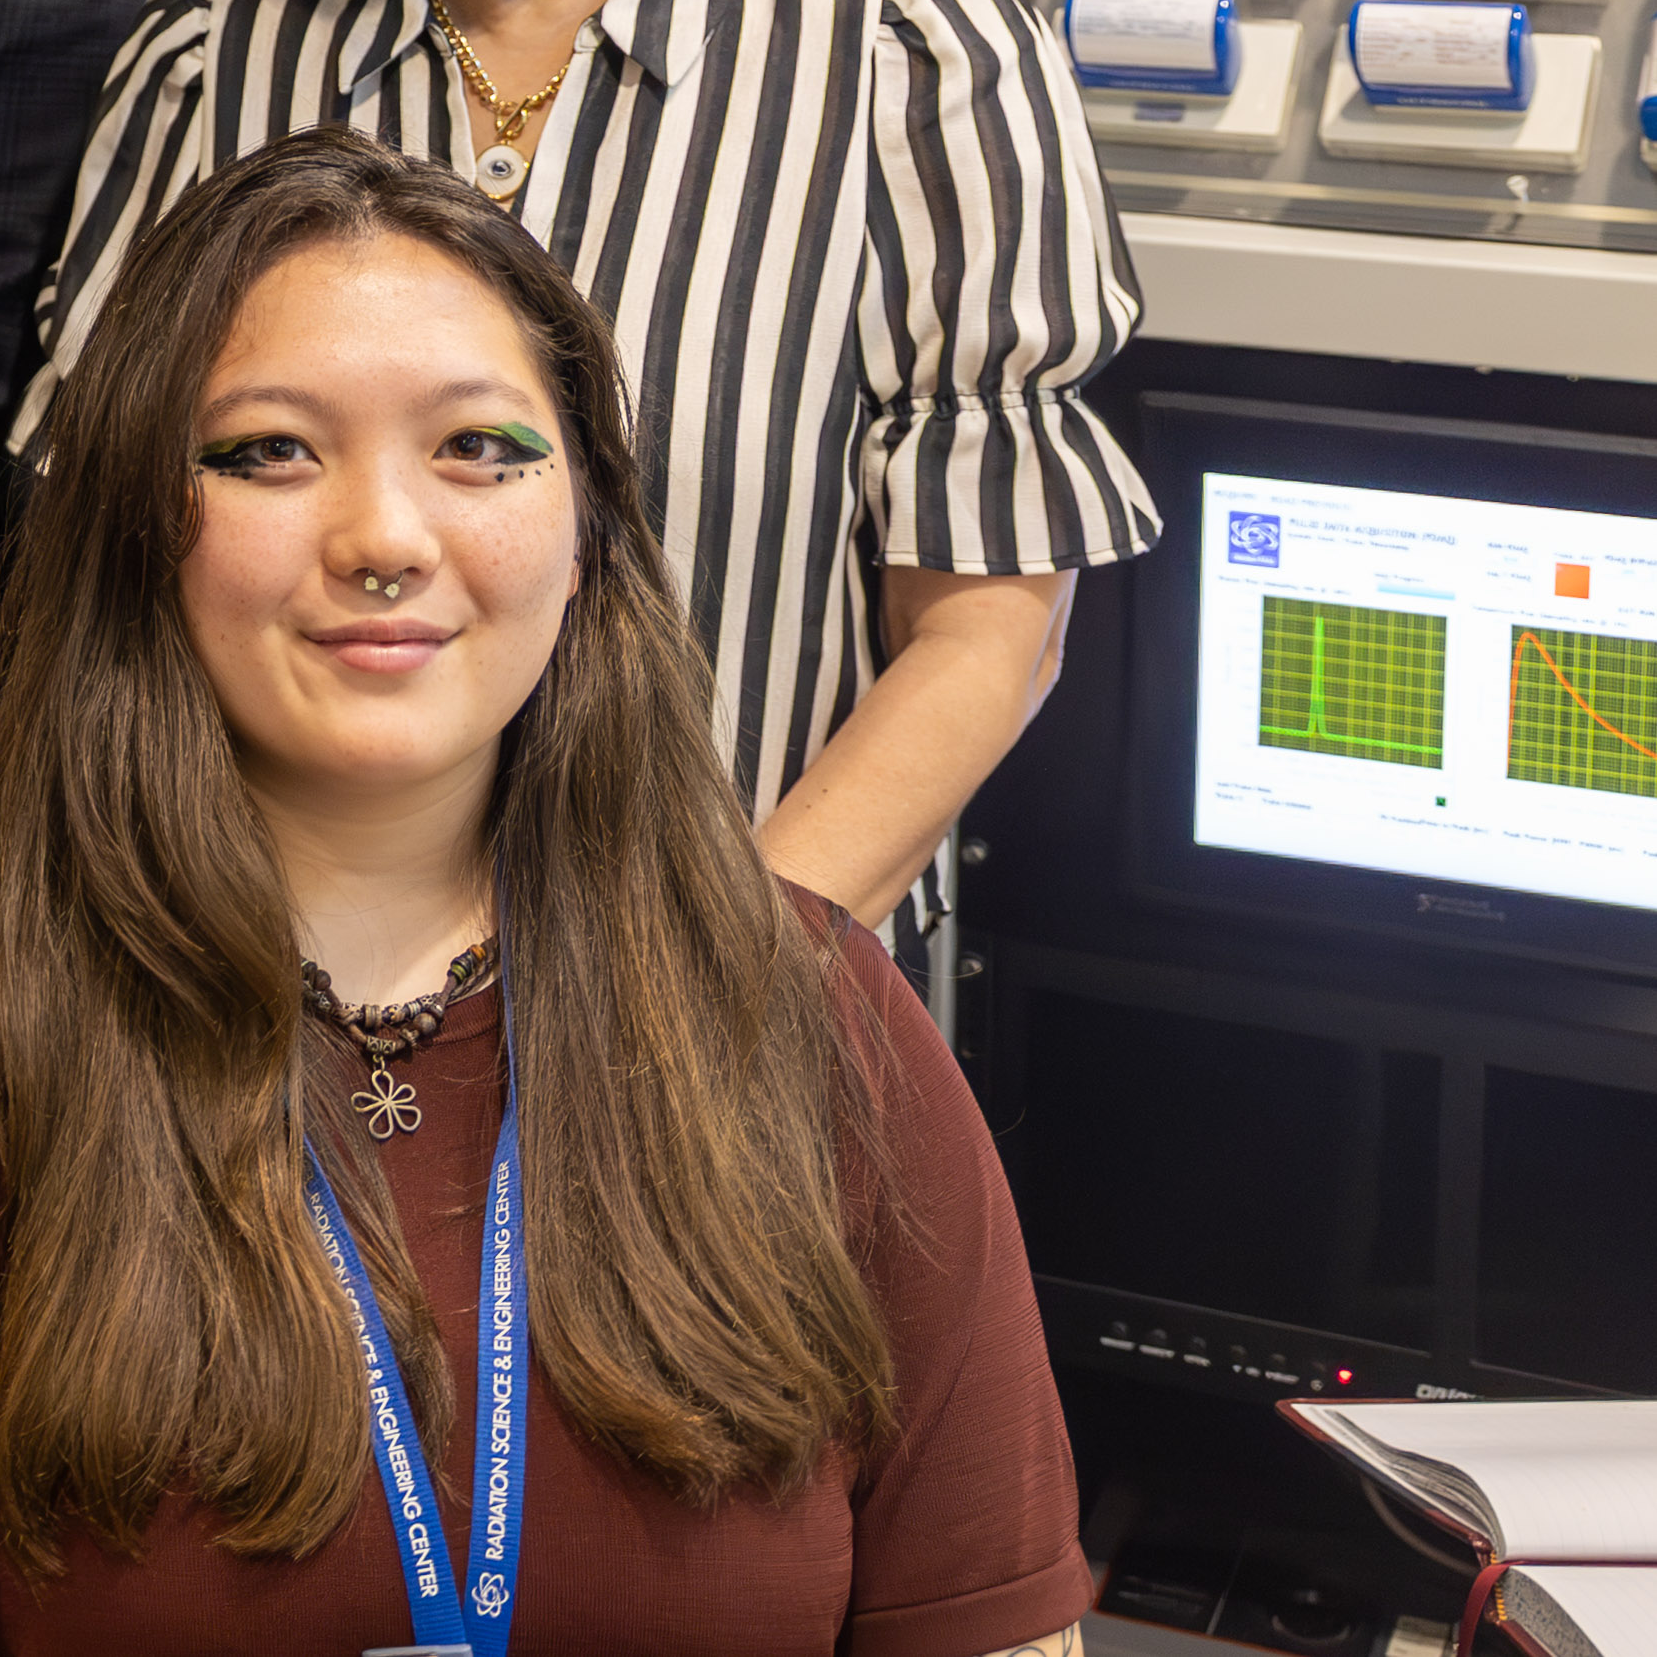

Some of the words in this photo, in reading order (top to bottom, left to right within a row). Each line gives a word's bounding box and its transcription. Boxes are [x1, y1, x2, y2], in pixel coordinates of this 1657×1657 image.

[494, 1158, 510, 1226] CENTER
[493, 1228, 513, 1353] ENGINEERING
[309, 1192, 351, 1284] RADIATION
[370, 1386, 423, 1521] ENGINEERING
[408, 1523, 440, 1599] CENTER
[493, 1354, 513, 1371] &
[491, 1373, 513, 1455] SCIENCE
[485, 1457, 509, 1561] RADIATION
